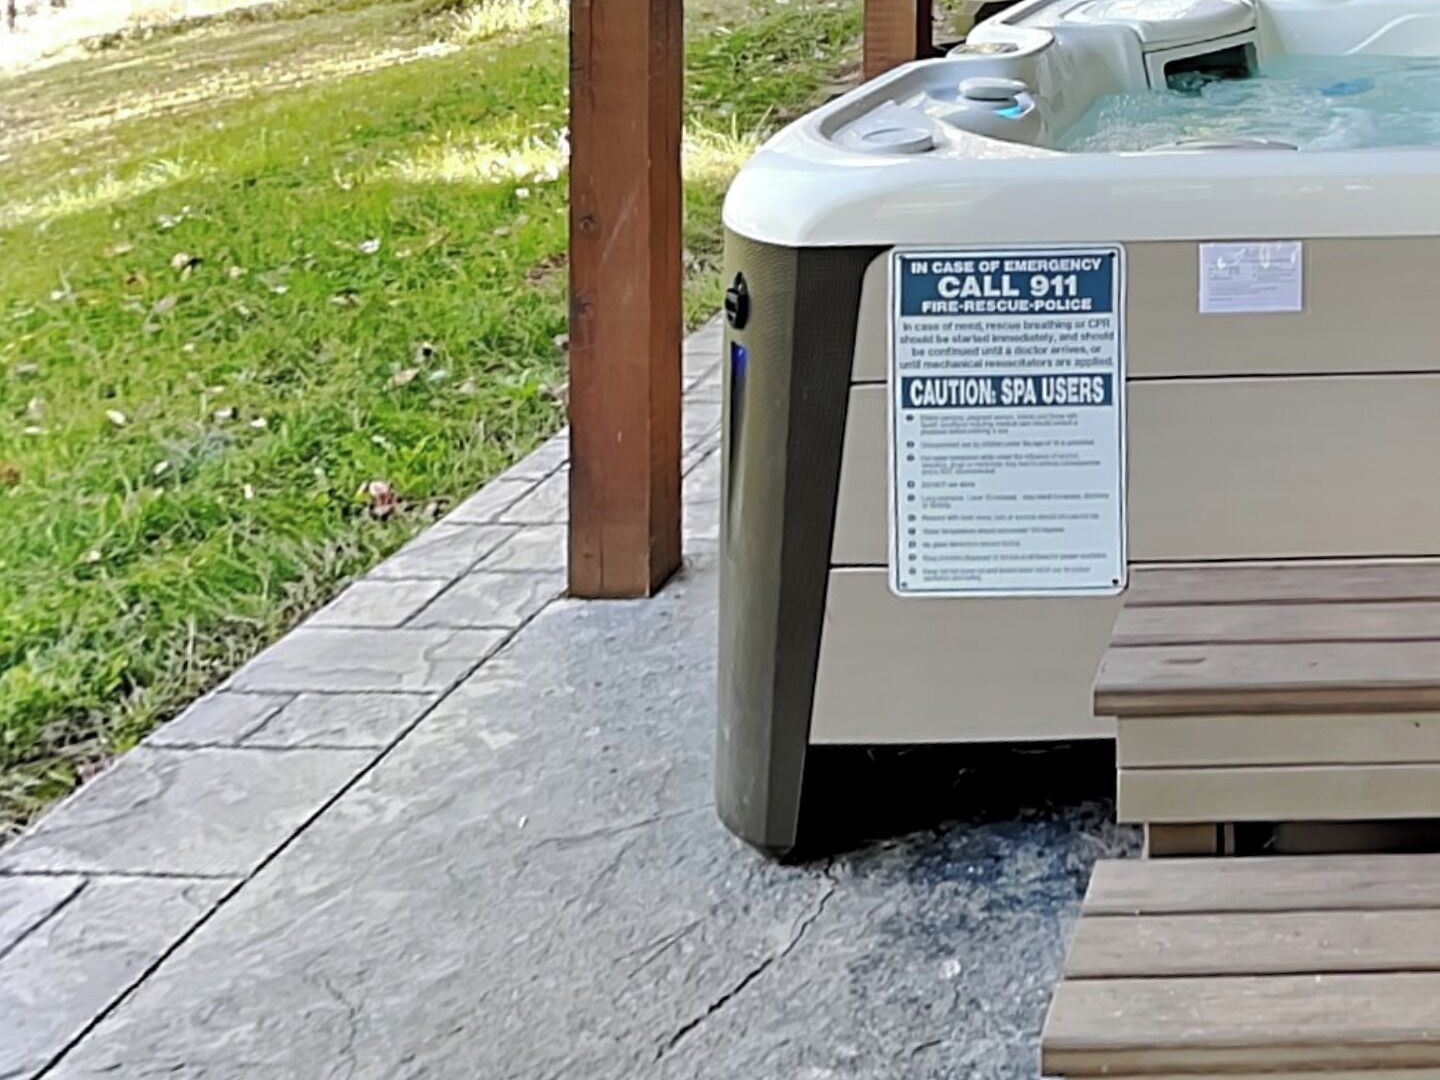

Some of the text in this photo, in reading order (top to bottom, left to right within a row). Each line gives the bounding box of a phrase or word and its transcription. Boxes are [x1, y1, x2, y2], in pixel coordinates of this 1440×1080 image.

[911, 258, 1101, 274] IN CASE OF EMERGENCY
[937, 274, 1078, 298] CALL 911
[921, 298, 1092, 313] FIRE-RESCUE-POLICE
[903, 318, 1110, 332] In case of need, rescue breathing or CPR
[900, 331, 1114, 344] should be started immediately, and should
[912, 348, 925, 357] be
[928, 346, 979, 356] continued
[981, 346, 1003, 355] until
[1014, 344, 1048, 354] doctor
[1050, 344, 1087, 355] arrives,
[1090, 345, 1101, 353] or
[899, 360, 921, 369] until
[923, 358, 983, 368] mechanical
[1055, 357, 1072, 366] are
[909, 377, 1105, 406] CAUTION: SPA USERS
